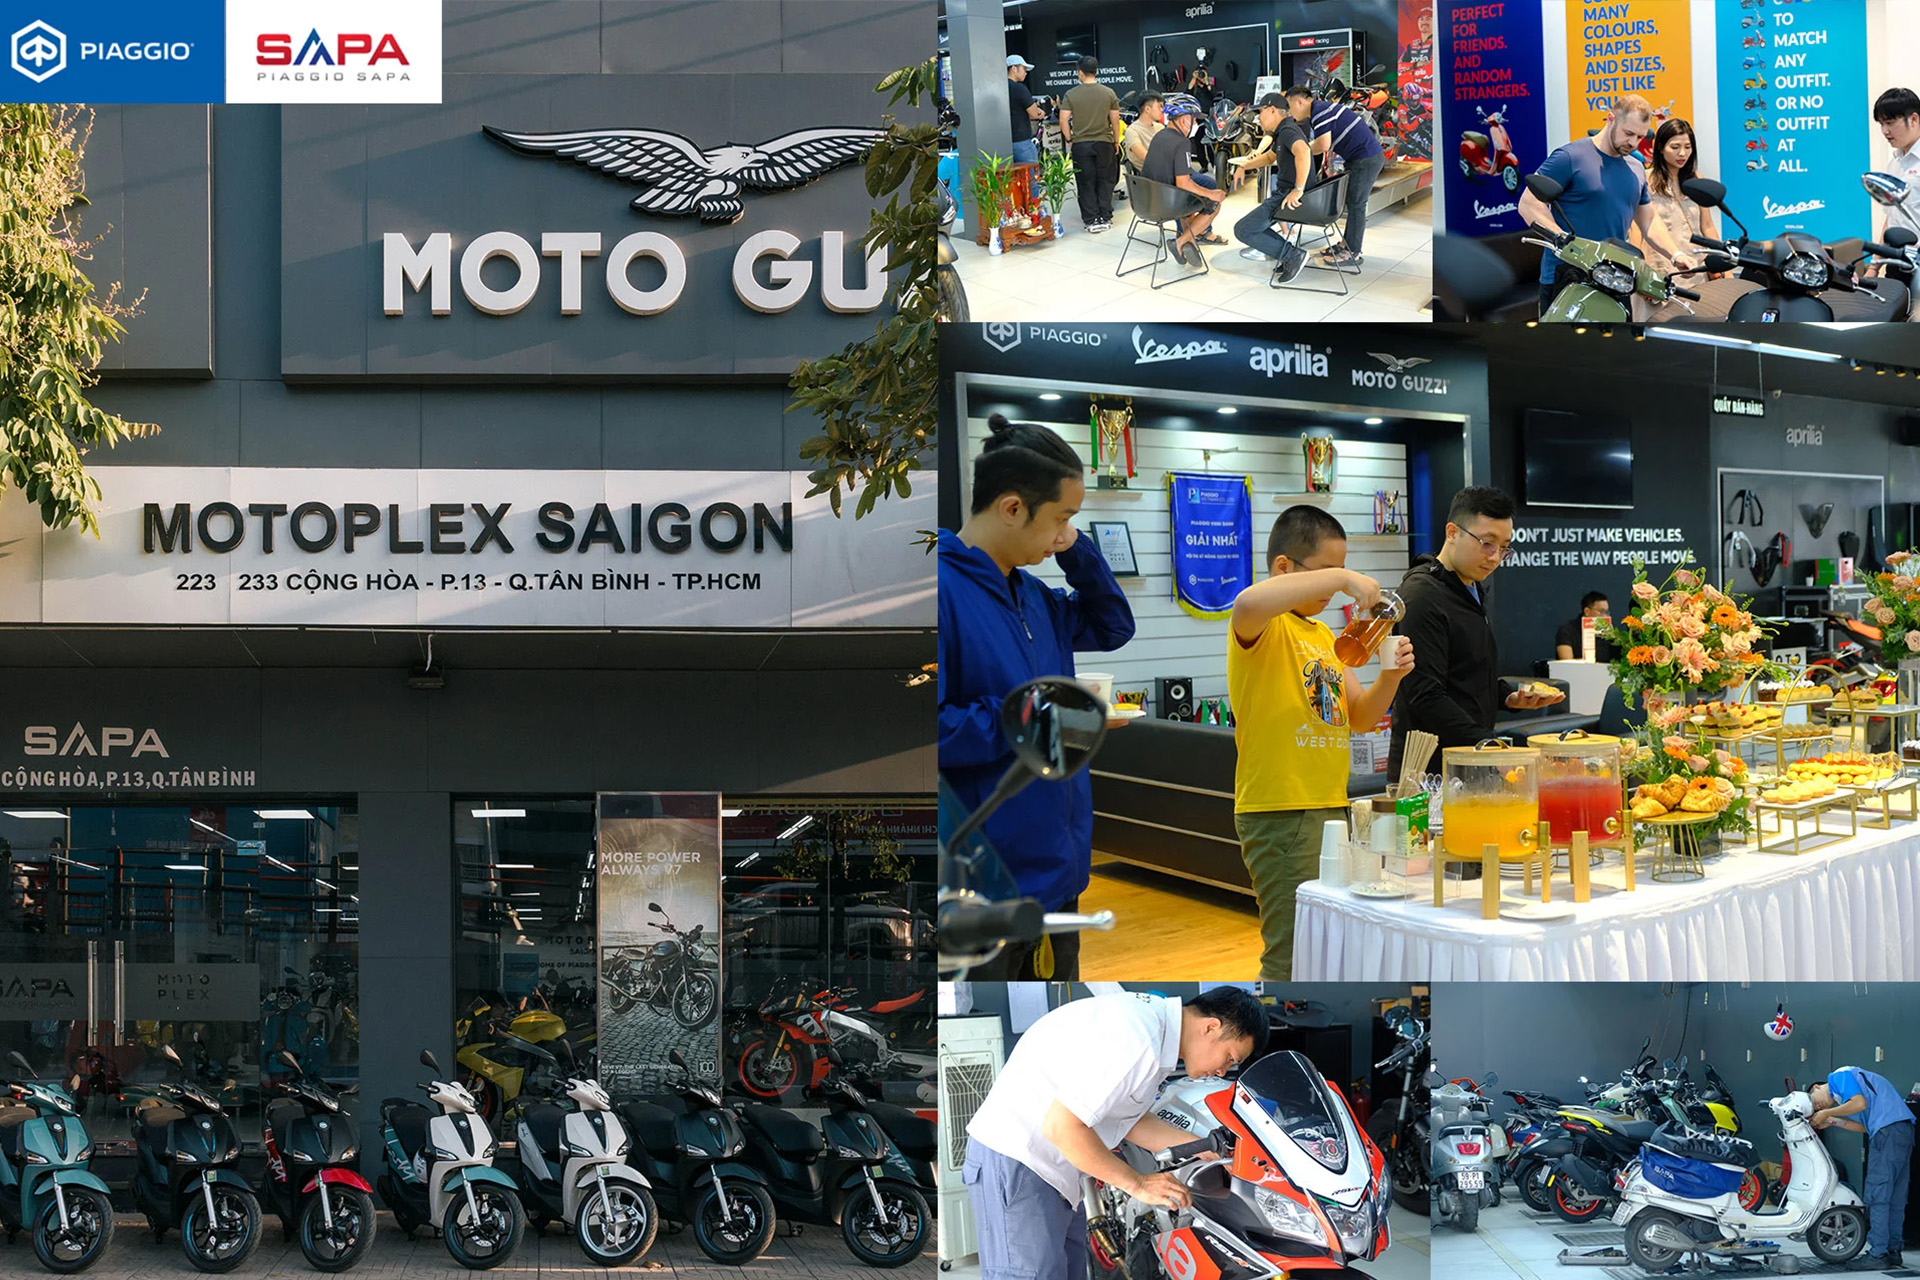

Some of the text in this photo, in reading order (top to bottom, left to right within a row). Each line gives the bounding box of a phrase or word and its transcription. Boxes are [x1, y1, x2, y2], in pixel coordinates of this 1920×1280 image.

[1185, 3, 1213, 18] aprilia
[1451, 3, 1505, 22] PERFECT
[1583, 3, 1630, 22] MANY
[1773, 12, 1794, 27] TO
[1452, 23, 1477, 38] FOR
[1583, 19, 1659, 40] COLOURS,
[1774, 30, 1828, 48] MATCH
[1453, 35, 1508, 54] FRIENDS.
[1584, 39, 1642, 58] SHAPES
[1453, 54, 1482, 70] AND
[1585, 56, 1666, 76] AND SIZES,
[1774, 53, 1807, 69] ANY
[1454, 68, 1512, 85] RANDOM
[1585, 75, 1656, 94] JUST LIKE
[1775, 73, 1831, 89] OUTFIT.
[1455, 83, 1530, 101] STRANGERS.
[1775, 95, 1824, 110] OR NO
[1776, 116, 1830, 131] OUTFIT
[1777, 138, 1796, 152] AT
[1777, 159, 1808, 173] ALL.
[1473, 199, 1518, 219] Vespa
[1762, 195, 1825, 220] Vespa
[382, 230, 688, 317] MOTO
[1030, 326, 1102, 347] PIAGGIO
[1131, 324, 1228, 365] Vespa
[1249, 343, 1329, 378] aprilia
[1351, 369, 1448, 395] MOTO GUZZI
[1786, 424, 1823, 447] aprilia
[142, 501, 794, 554] MOTOPLEX SAIGON
[1551, 528, 1584, 543] JUST
[1586, 528, 1622, 543] MAKE
[1624, 528, 1685, 543] VEHICLES.
[1500, 550, 1697, 567] HANGE THE WAY PEOPLE MOVE.
[176, 573, 217, 591] 223
[239, 573, 278, 591] 233
[286, 569, 358, 594] CỘNG
[366, 569, 420, 591] HÒA
[441, 573, 486, 591] P.13
[509, 569, 583, 592] Q.TÂN
[591, 569, 650, 590] BÌNH
[672, 573, 761, 590] TP.HCM
[23, 721, 171, 759] SAPA
[1295, 736, 1335, 749] WEST
[601, 852, 701, 863] MORE POWER
[601, 864, 660, 875] ALWAYS
[0, 976, 74, 998] APA
[158, 989, 210, 1000] PLEX
[1156, 1107, 1191, 1130] aprilia
